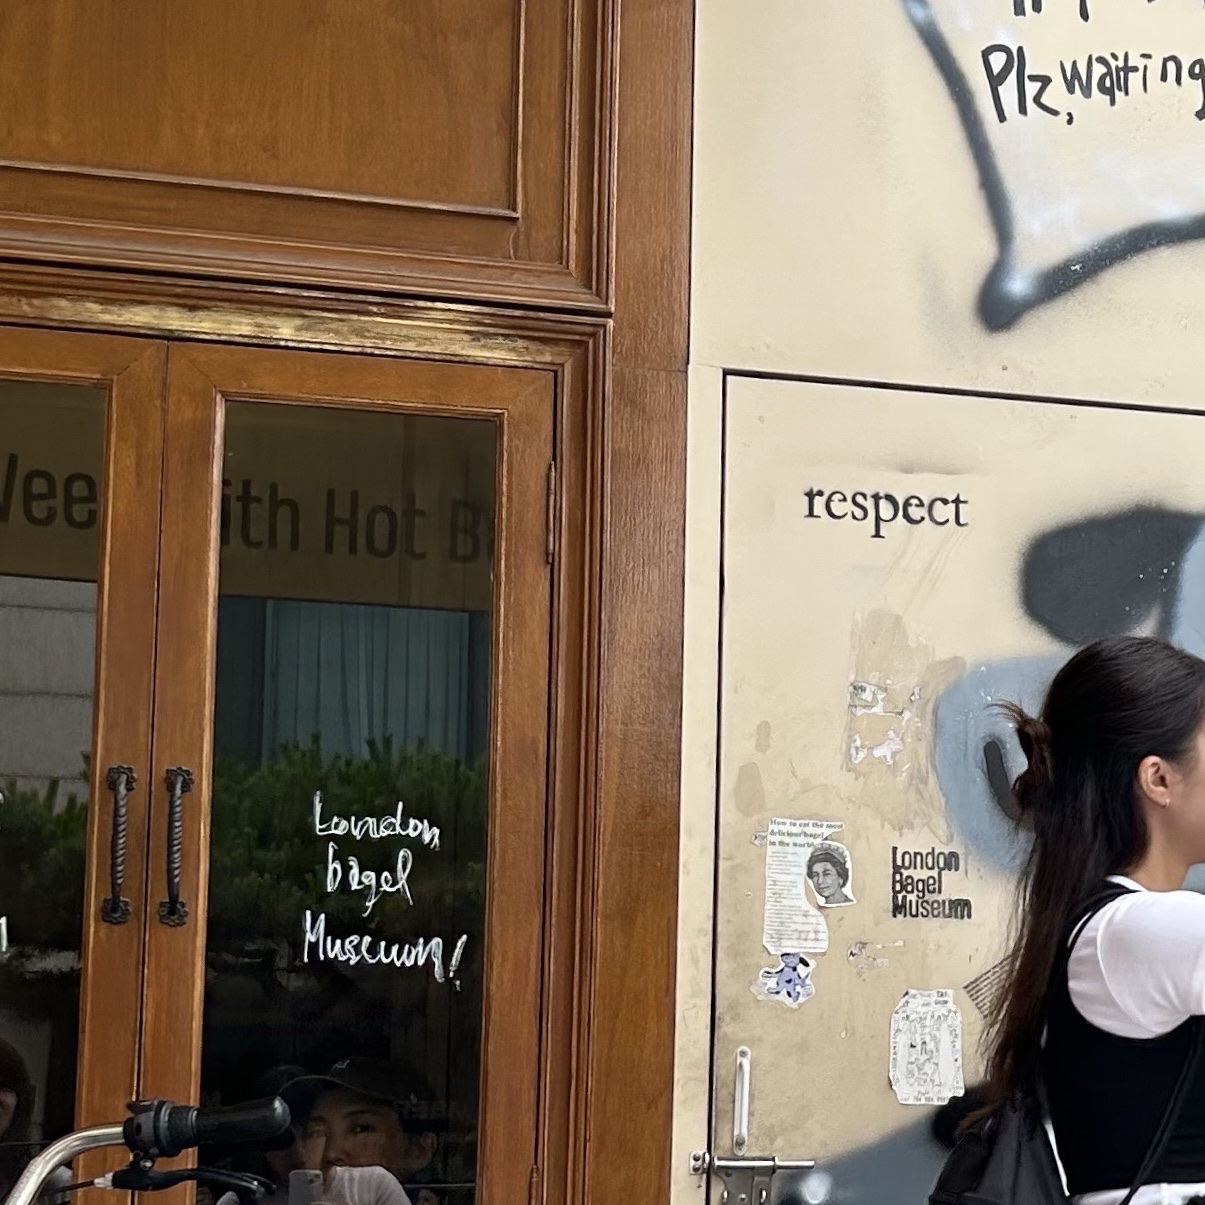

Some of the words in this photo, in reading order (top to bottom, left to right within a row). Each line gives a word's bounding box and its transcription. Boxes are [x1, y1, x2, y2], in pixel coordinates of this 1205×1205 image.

[324, 487, 427, 560] Hot
[803, 486, 970, 539] respect
[891, 846, 960, 872] London
[891, 870, 942, 899] Bagel
[892, 894, 972, 919] Museum
